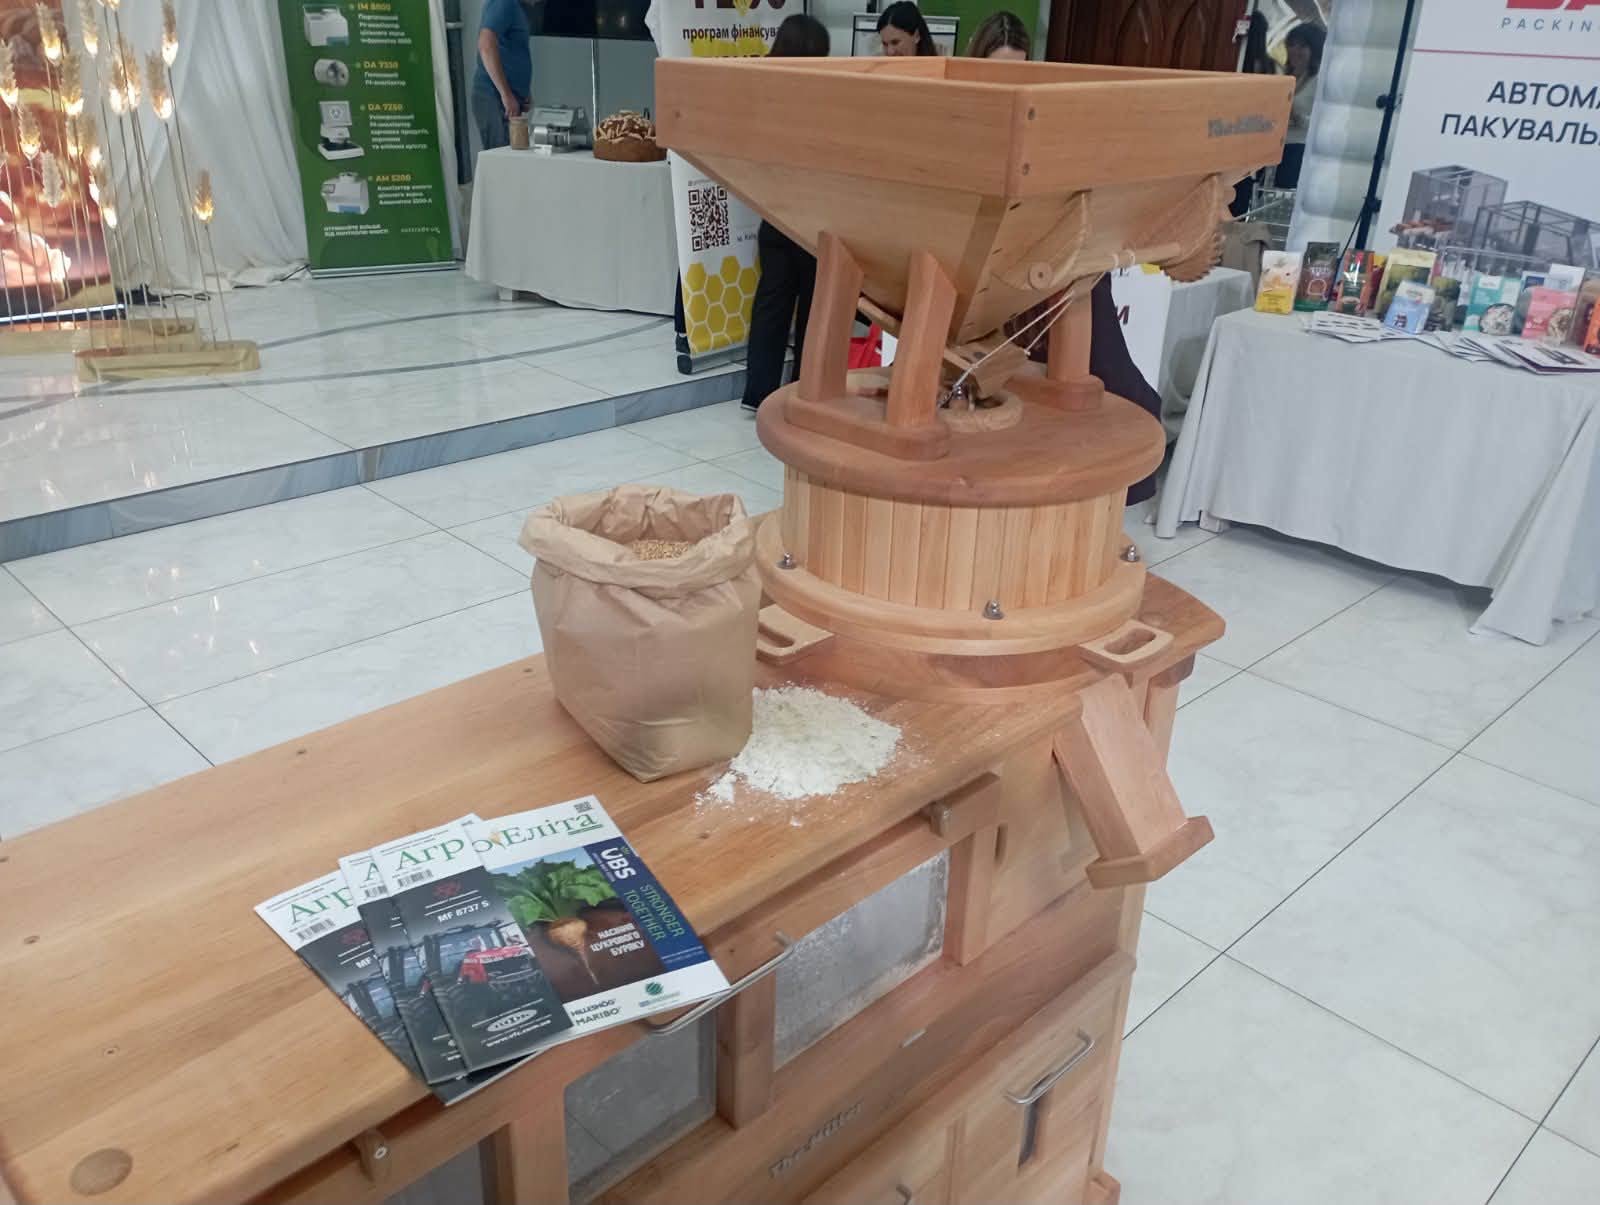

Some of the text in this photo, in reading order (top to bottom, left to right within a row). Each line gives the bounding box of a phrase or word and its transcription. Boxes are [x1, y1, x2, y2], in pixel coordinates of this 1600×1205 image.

[682, 26, 729, 42] програм
[1501, 17, 1600, 32] PACKIN
[1486, 81, 1600, 110] АВТОМ
[1440, 113, 1600, 146] ПАКУВАЛЬ
[600, 847, 637, 880] UBS
[623, 889, 667, 941] TOGETHER
[640, 884, 685, 937] STRONGER
